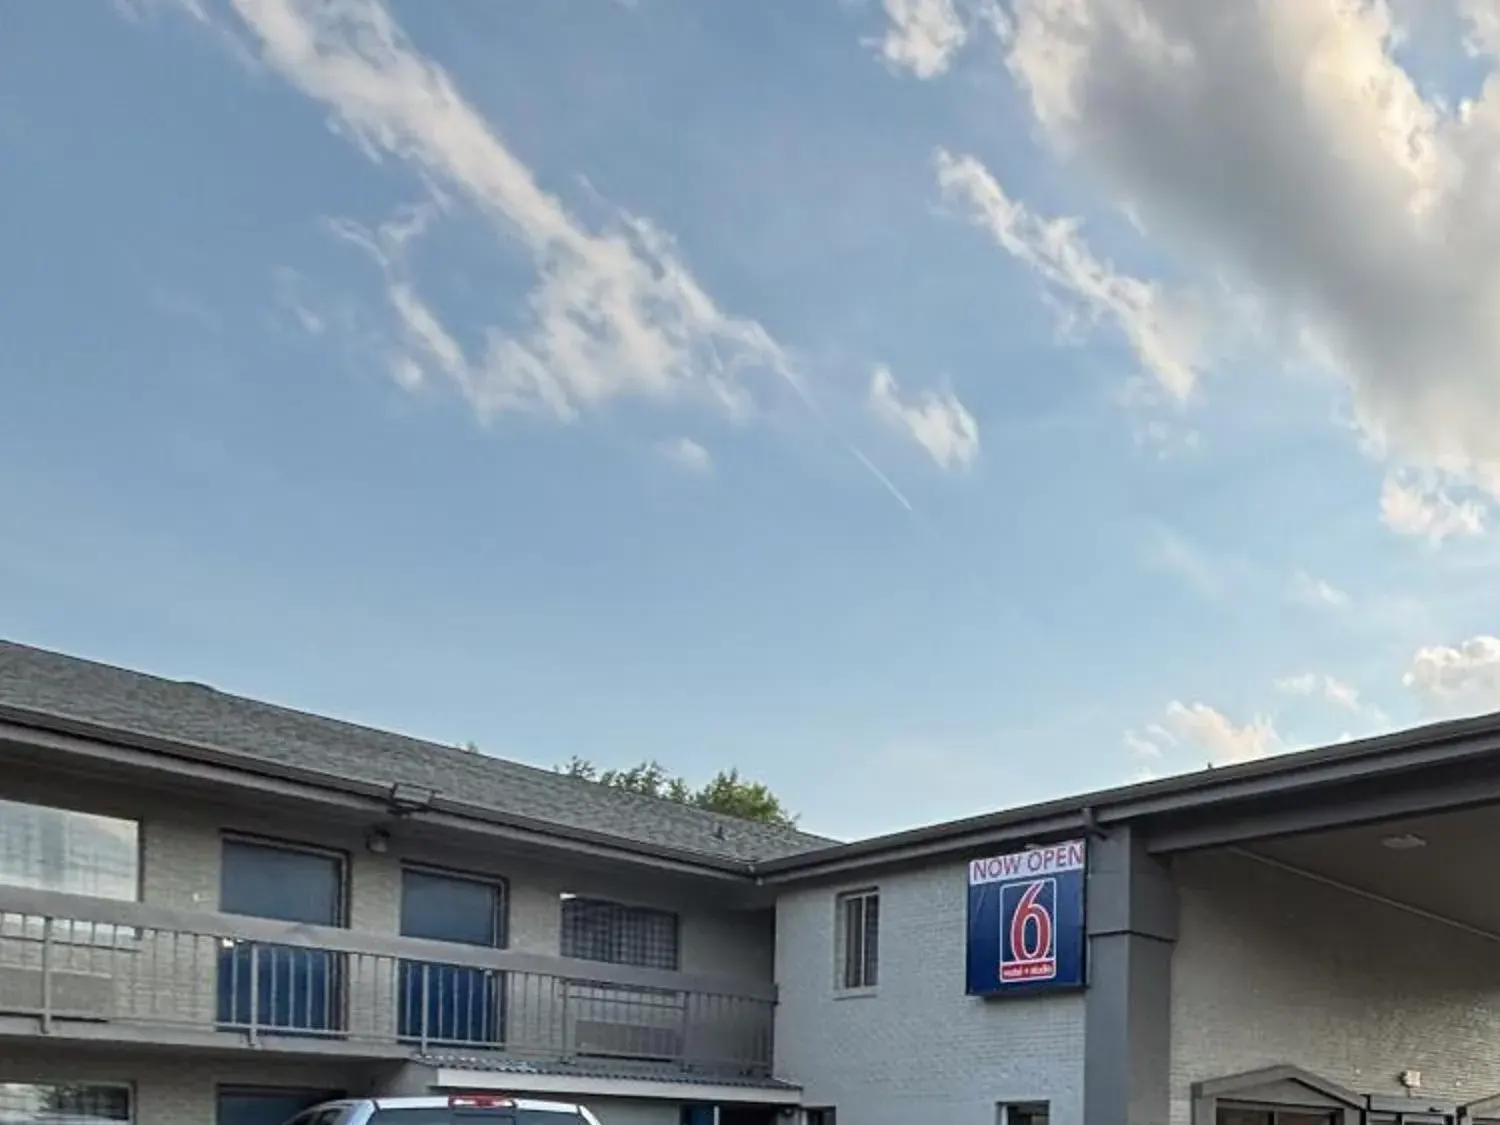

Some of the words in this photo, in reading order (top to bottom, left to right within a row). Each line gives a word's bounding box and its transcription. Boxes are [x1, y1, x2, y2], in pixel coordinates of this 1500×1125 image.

[974, 855, 1021, 880] NOW
[1028, 845, 1084, 871] OPEN
[1011, 880, 1051, 961] 6
